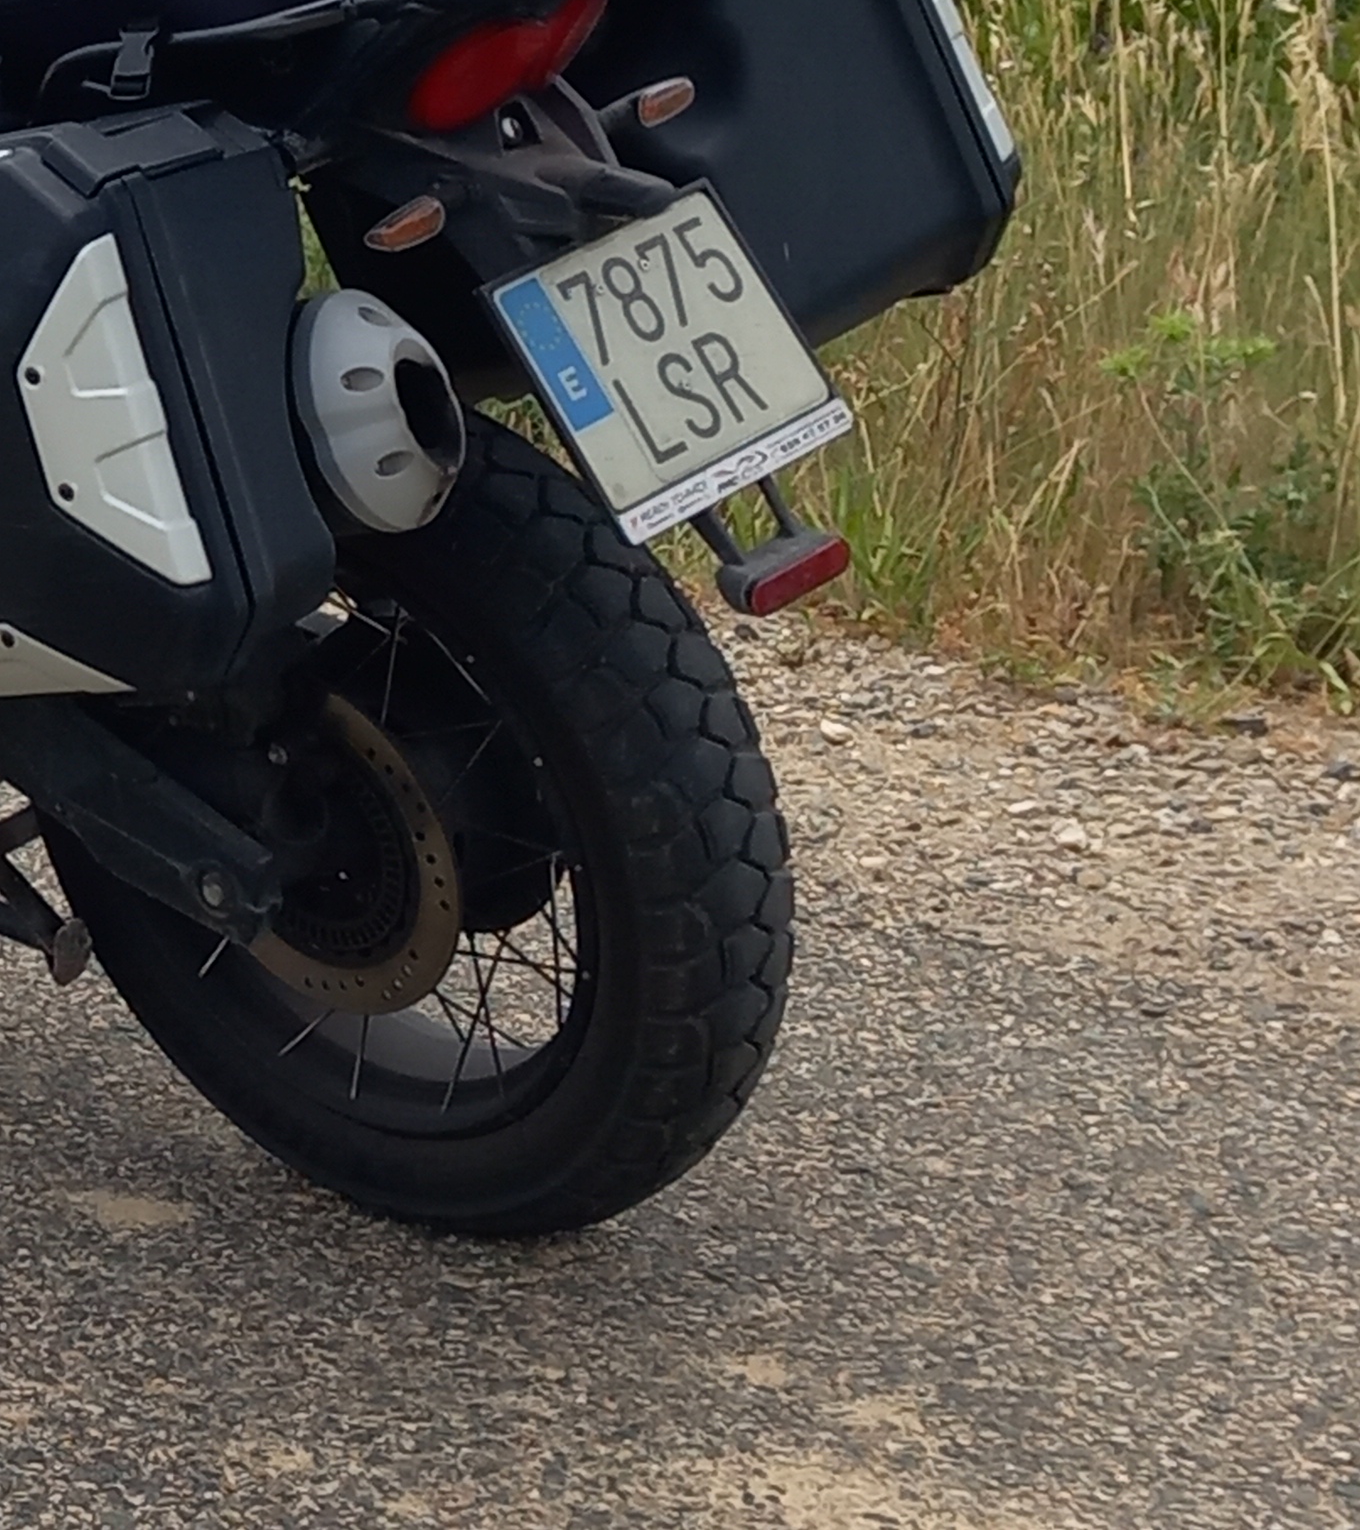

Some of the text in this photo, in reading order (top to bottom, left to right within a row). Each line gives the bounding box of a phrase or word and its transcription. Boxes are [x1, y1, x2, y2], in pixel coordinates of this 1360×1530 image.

[555, 216, 744, 367] 7875
[556, 365, 588, 402] E
[612, 331, 769, 465] LSR
